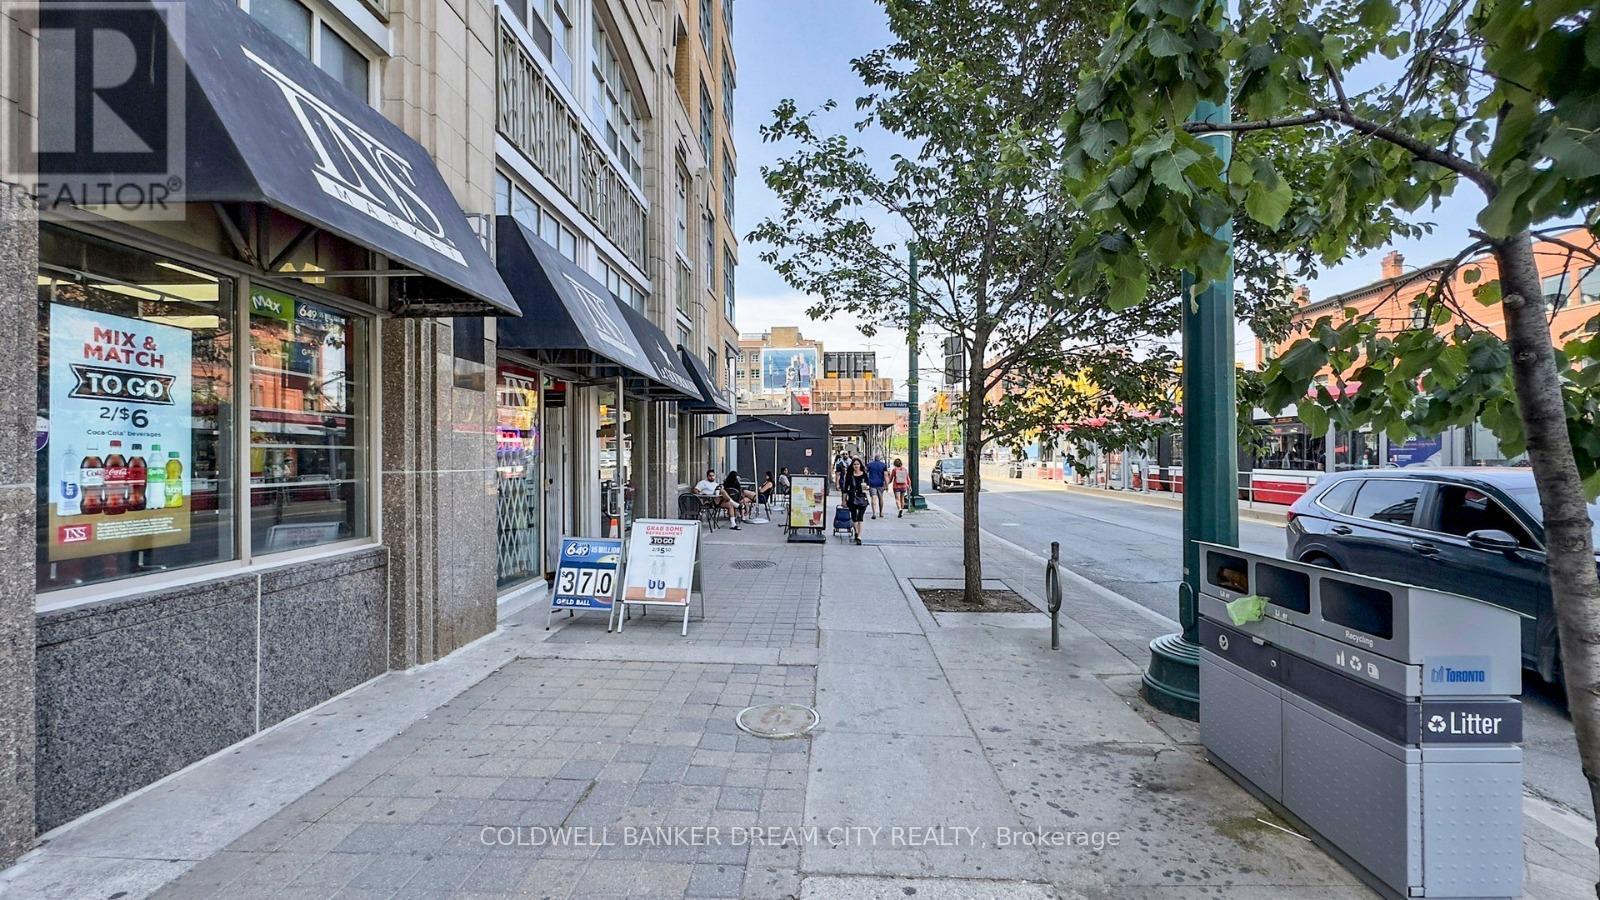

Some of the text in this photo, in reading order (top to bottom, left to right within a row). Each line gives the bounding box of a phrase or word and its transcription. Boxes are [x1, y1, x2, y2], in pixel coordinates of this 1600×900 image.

[335, 185, 457, 259] MARKET
[252, 295, 280, 313] MAX
[300, 304, 317, 319] 649
[94, 327, 157, 351] MIX &
[84, 343, 164, 368] MATCH
[86, 372, 163, 398] TO GO
[100, 406, 149, 428] 2/$6
[127, 430, 162, 438] beverages
[566, 542, 589, 556] 649
[1345, 630, 1374, 648] Recycling
[1445, 668, 1485, 682] TORONTO
[1450, 712, 1502, 734] Litter
